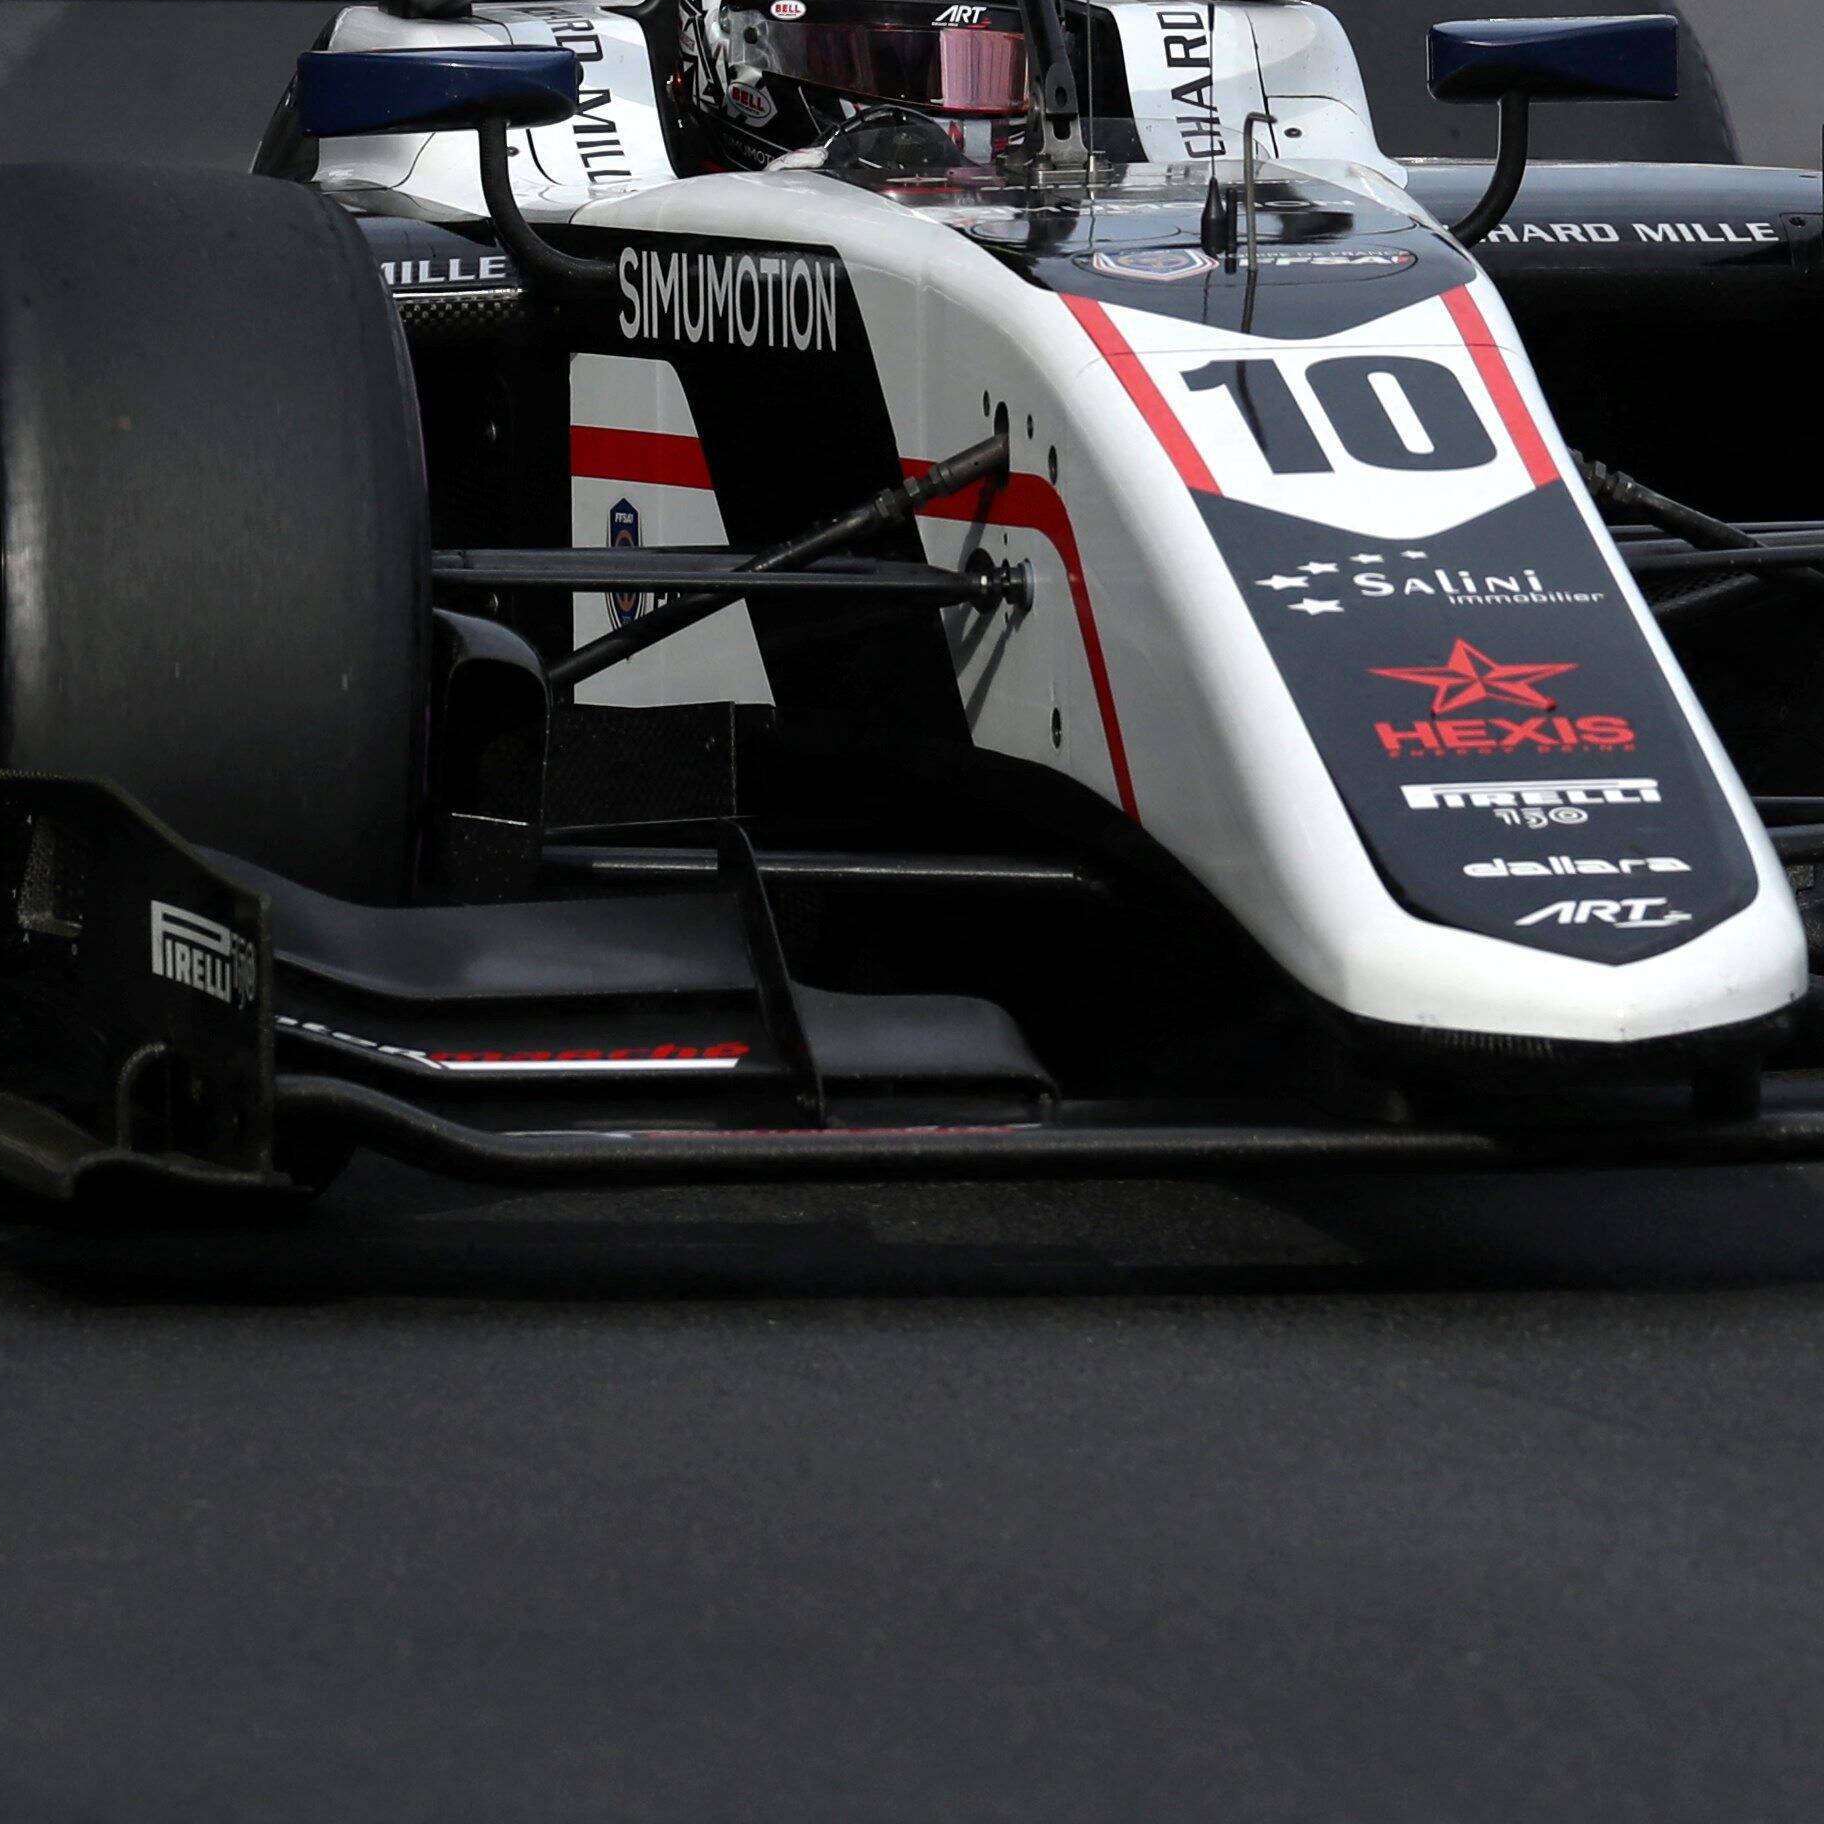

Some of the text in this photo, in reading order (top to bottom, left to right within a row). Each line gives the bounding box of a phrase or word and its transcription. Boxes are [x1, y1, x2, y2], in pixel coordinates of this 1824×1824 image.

[774, 3, 803, 14] BELL
[933, 4, 988, 24] ART
[731, 86, 767, 114] BELL
[572, 88, 632, 185] MILL
[1479, 222, 1780, 243] HARD MILLE
[619, 247, 837, 352] SIMUMOTION
[1180, 354, 1499, 476] 10
[1447, 591, 1607, 605] immobilier
[1373, 715, 1637, 751] HEXIS
[1400, 778, 1663, 810] PIRELLI
[1492, 806, 1590, 830] 150
[1462, 855, 1693, 878] dallara
[1513, 896, 1669, 927] ART
[150, 899, 231, 1005] PIRELLI
